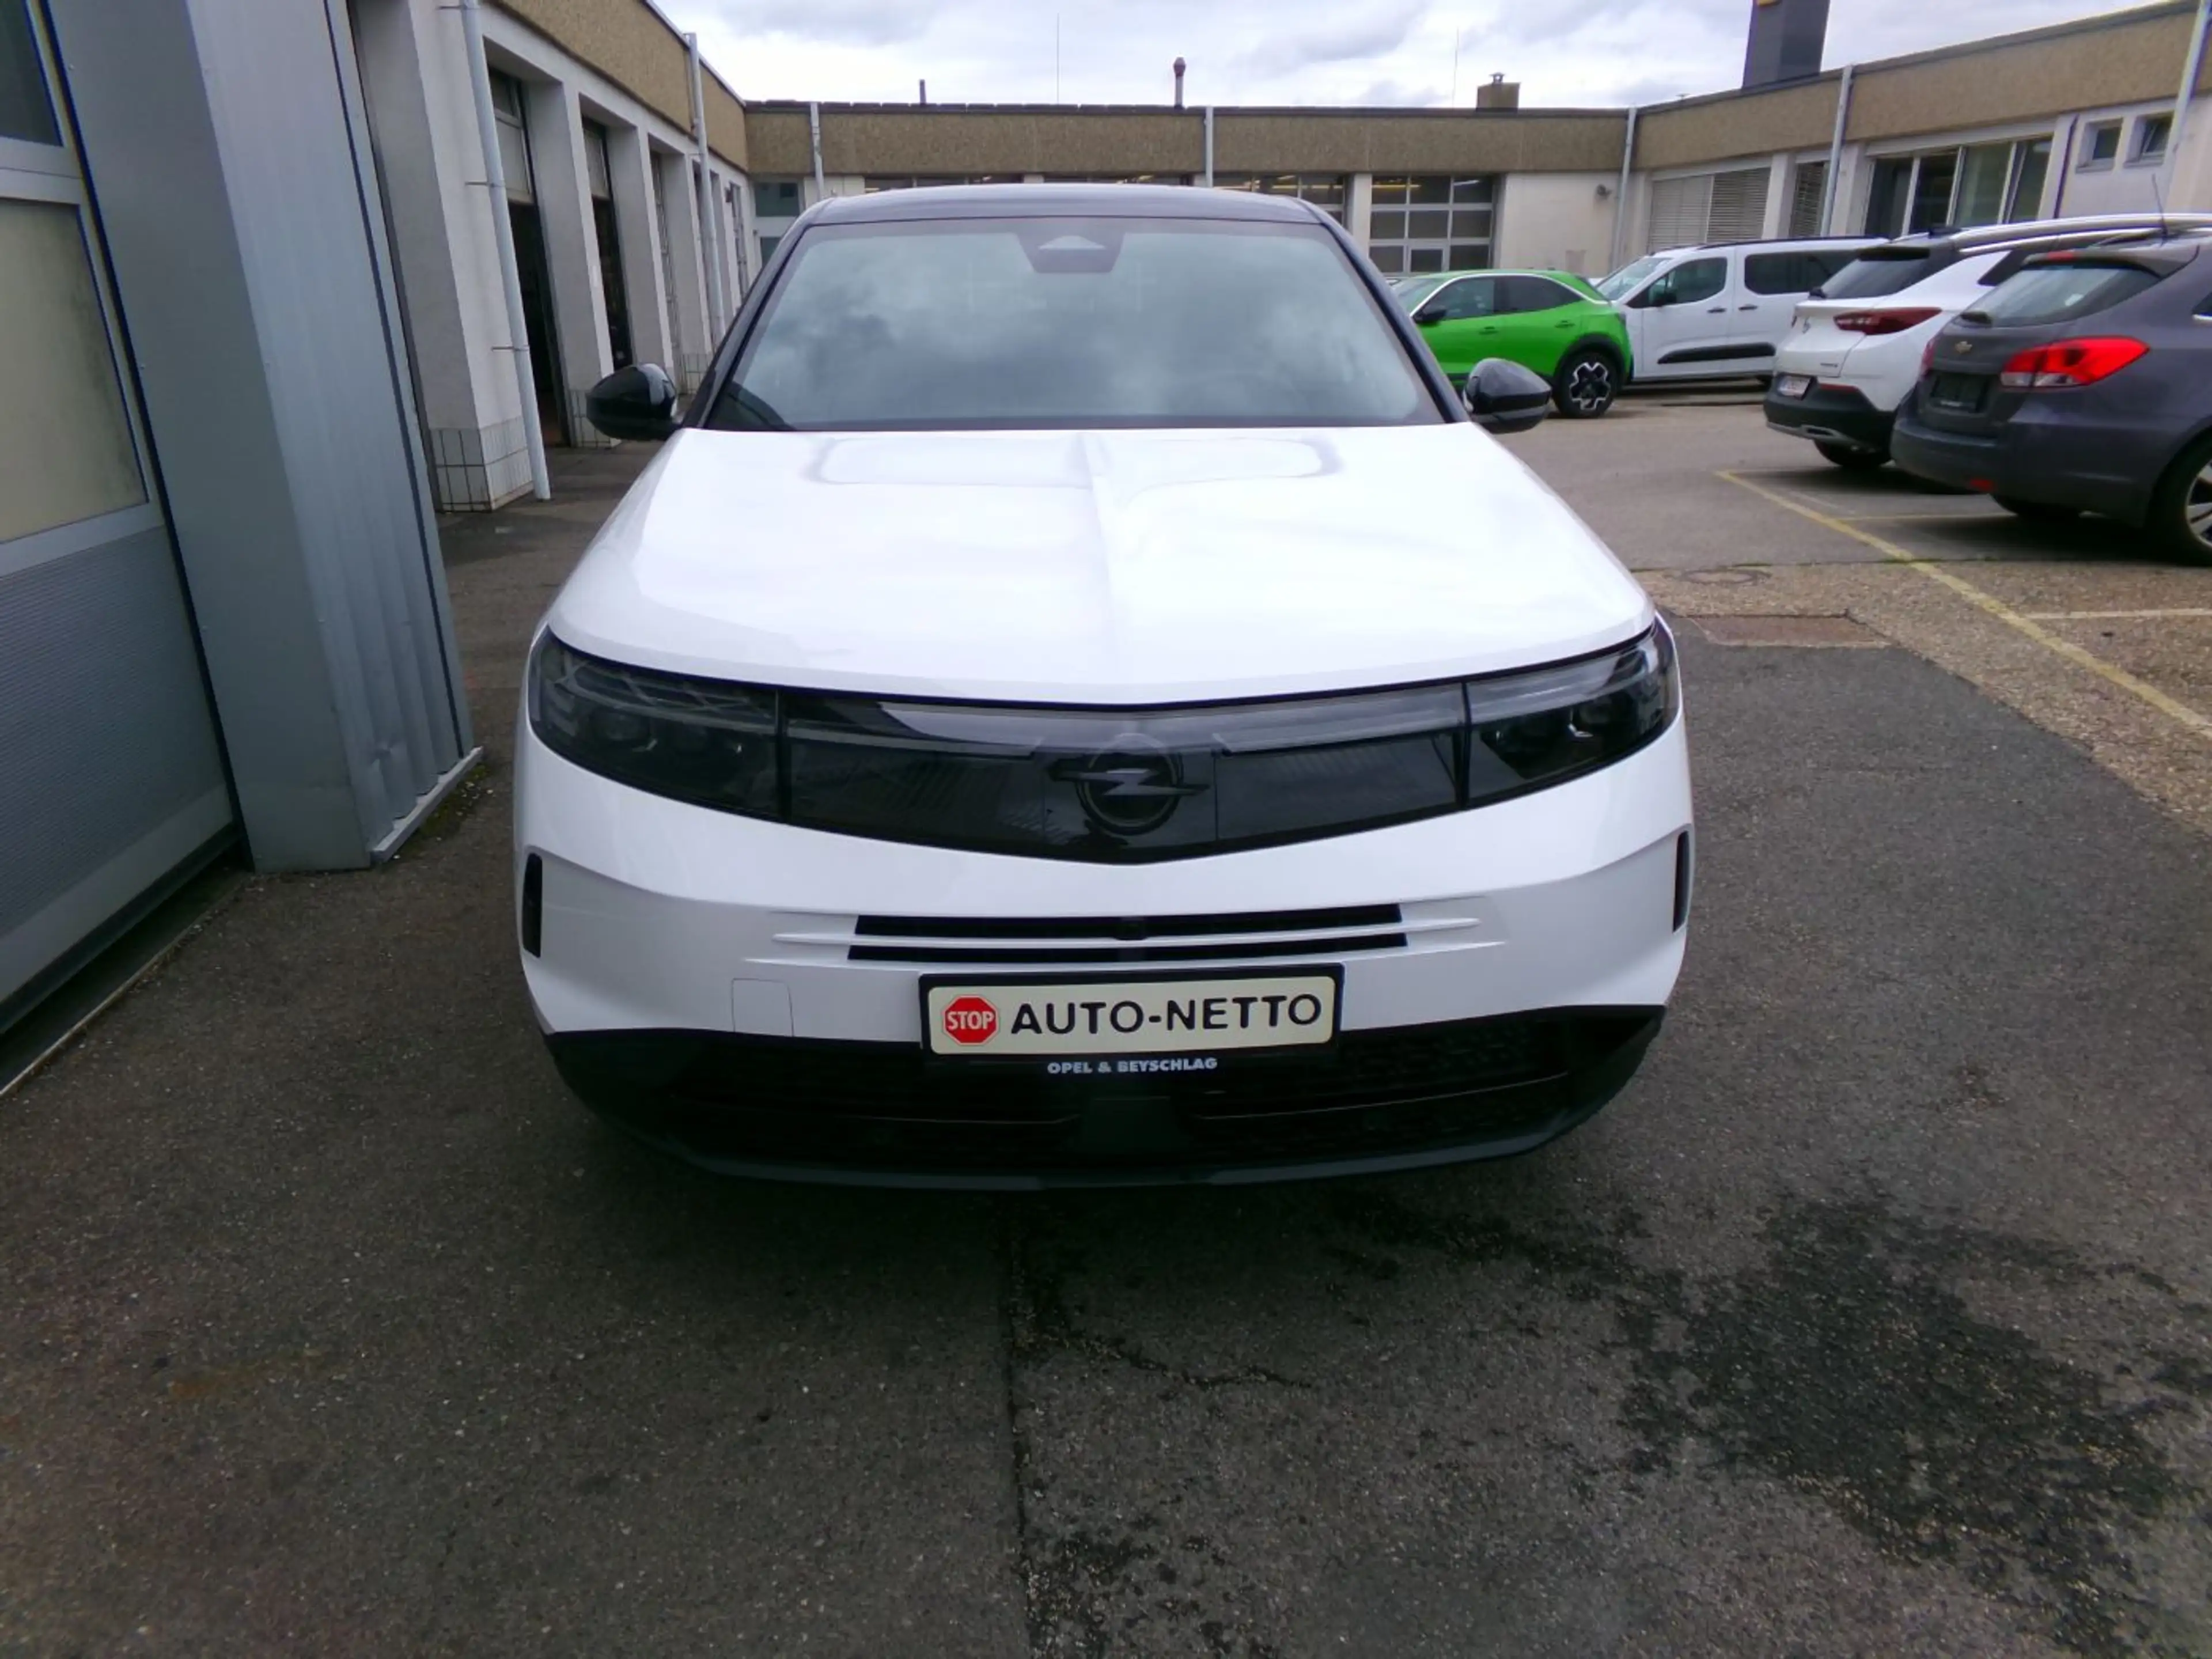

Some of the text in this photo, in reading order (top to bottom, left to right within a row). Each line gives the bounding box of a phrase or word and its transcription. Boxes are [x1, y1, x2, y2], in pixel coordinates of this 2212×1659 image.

[948, 994, 1321, 1035] STOP AUTO-NETTO
[1047, 1057, 1218, 1074] OPEL & BEYSCHLAG
